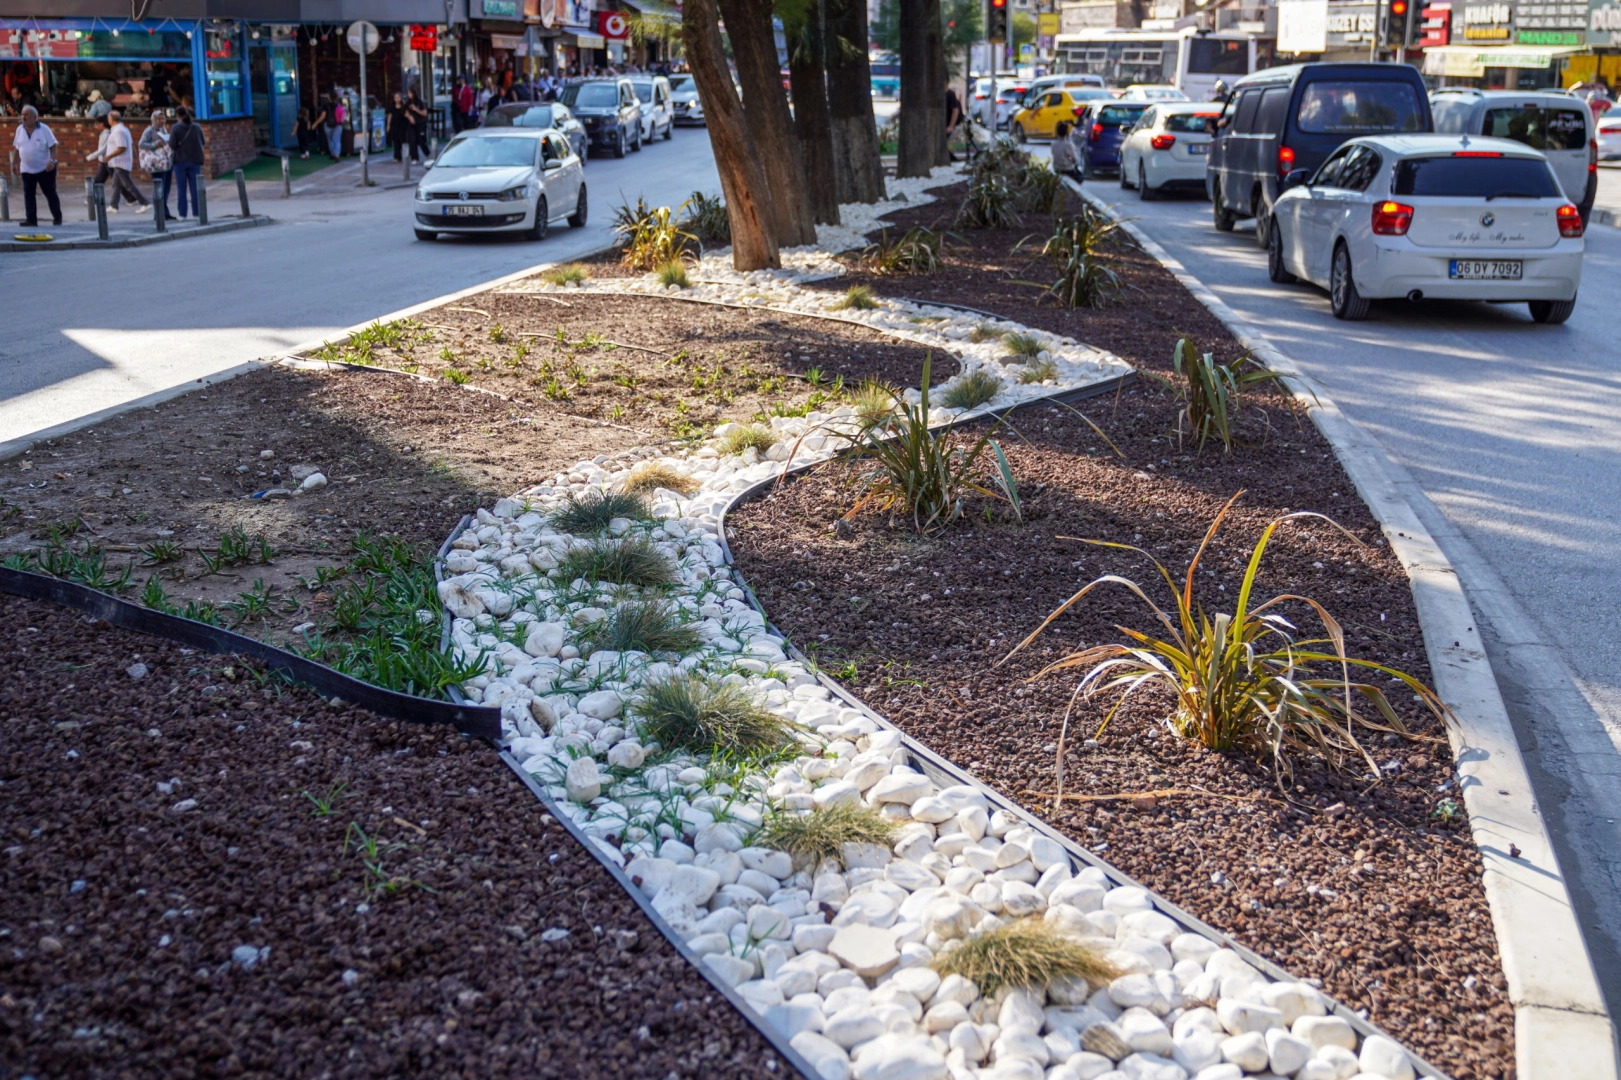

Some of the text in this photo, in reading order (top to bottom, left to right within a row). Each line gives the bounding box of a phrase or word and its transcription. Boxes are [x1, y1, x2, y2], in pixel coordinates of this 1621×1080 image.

[1456, 262, 1520, 275] 06 DY 7092
